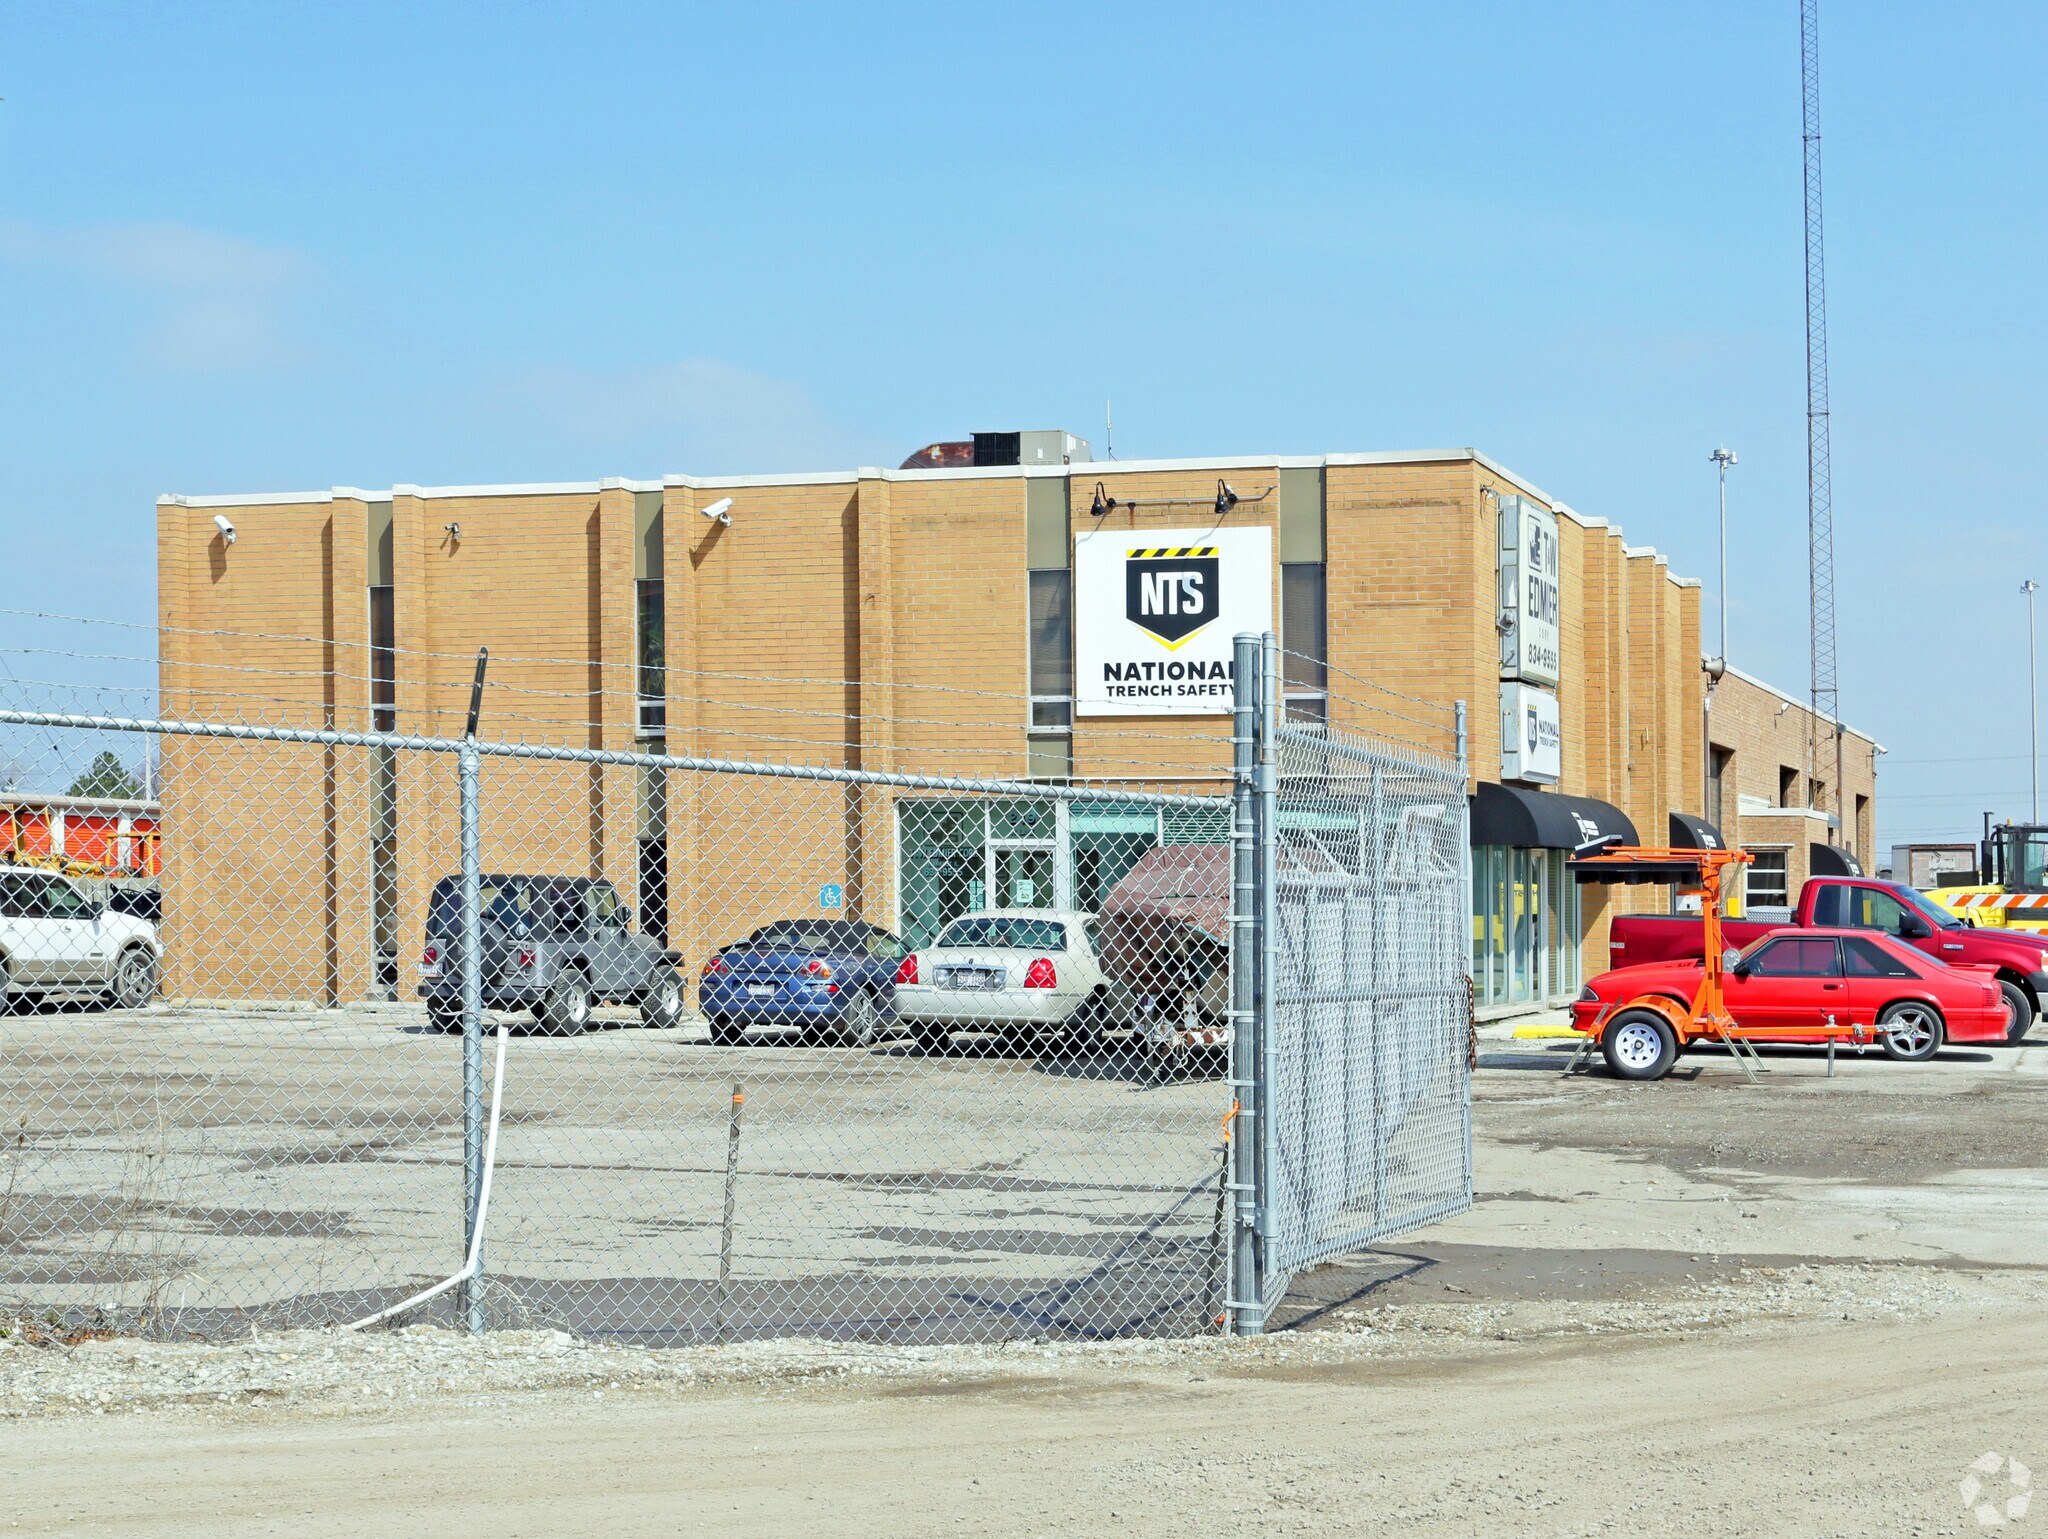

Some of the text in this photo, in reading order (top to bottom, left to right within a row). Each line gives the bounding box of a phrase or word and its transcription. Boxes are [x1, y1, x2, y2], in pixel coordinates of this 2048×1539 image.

[1141, 571, 1204, 616] NTS
[1528, 574, 1558, 628] EDMIER
[1528, 643, 1557, 671] 834-9555
[1106, 685, 1172, 697] TRENCH
